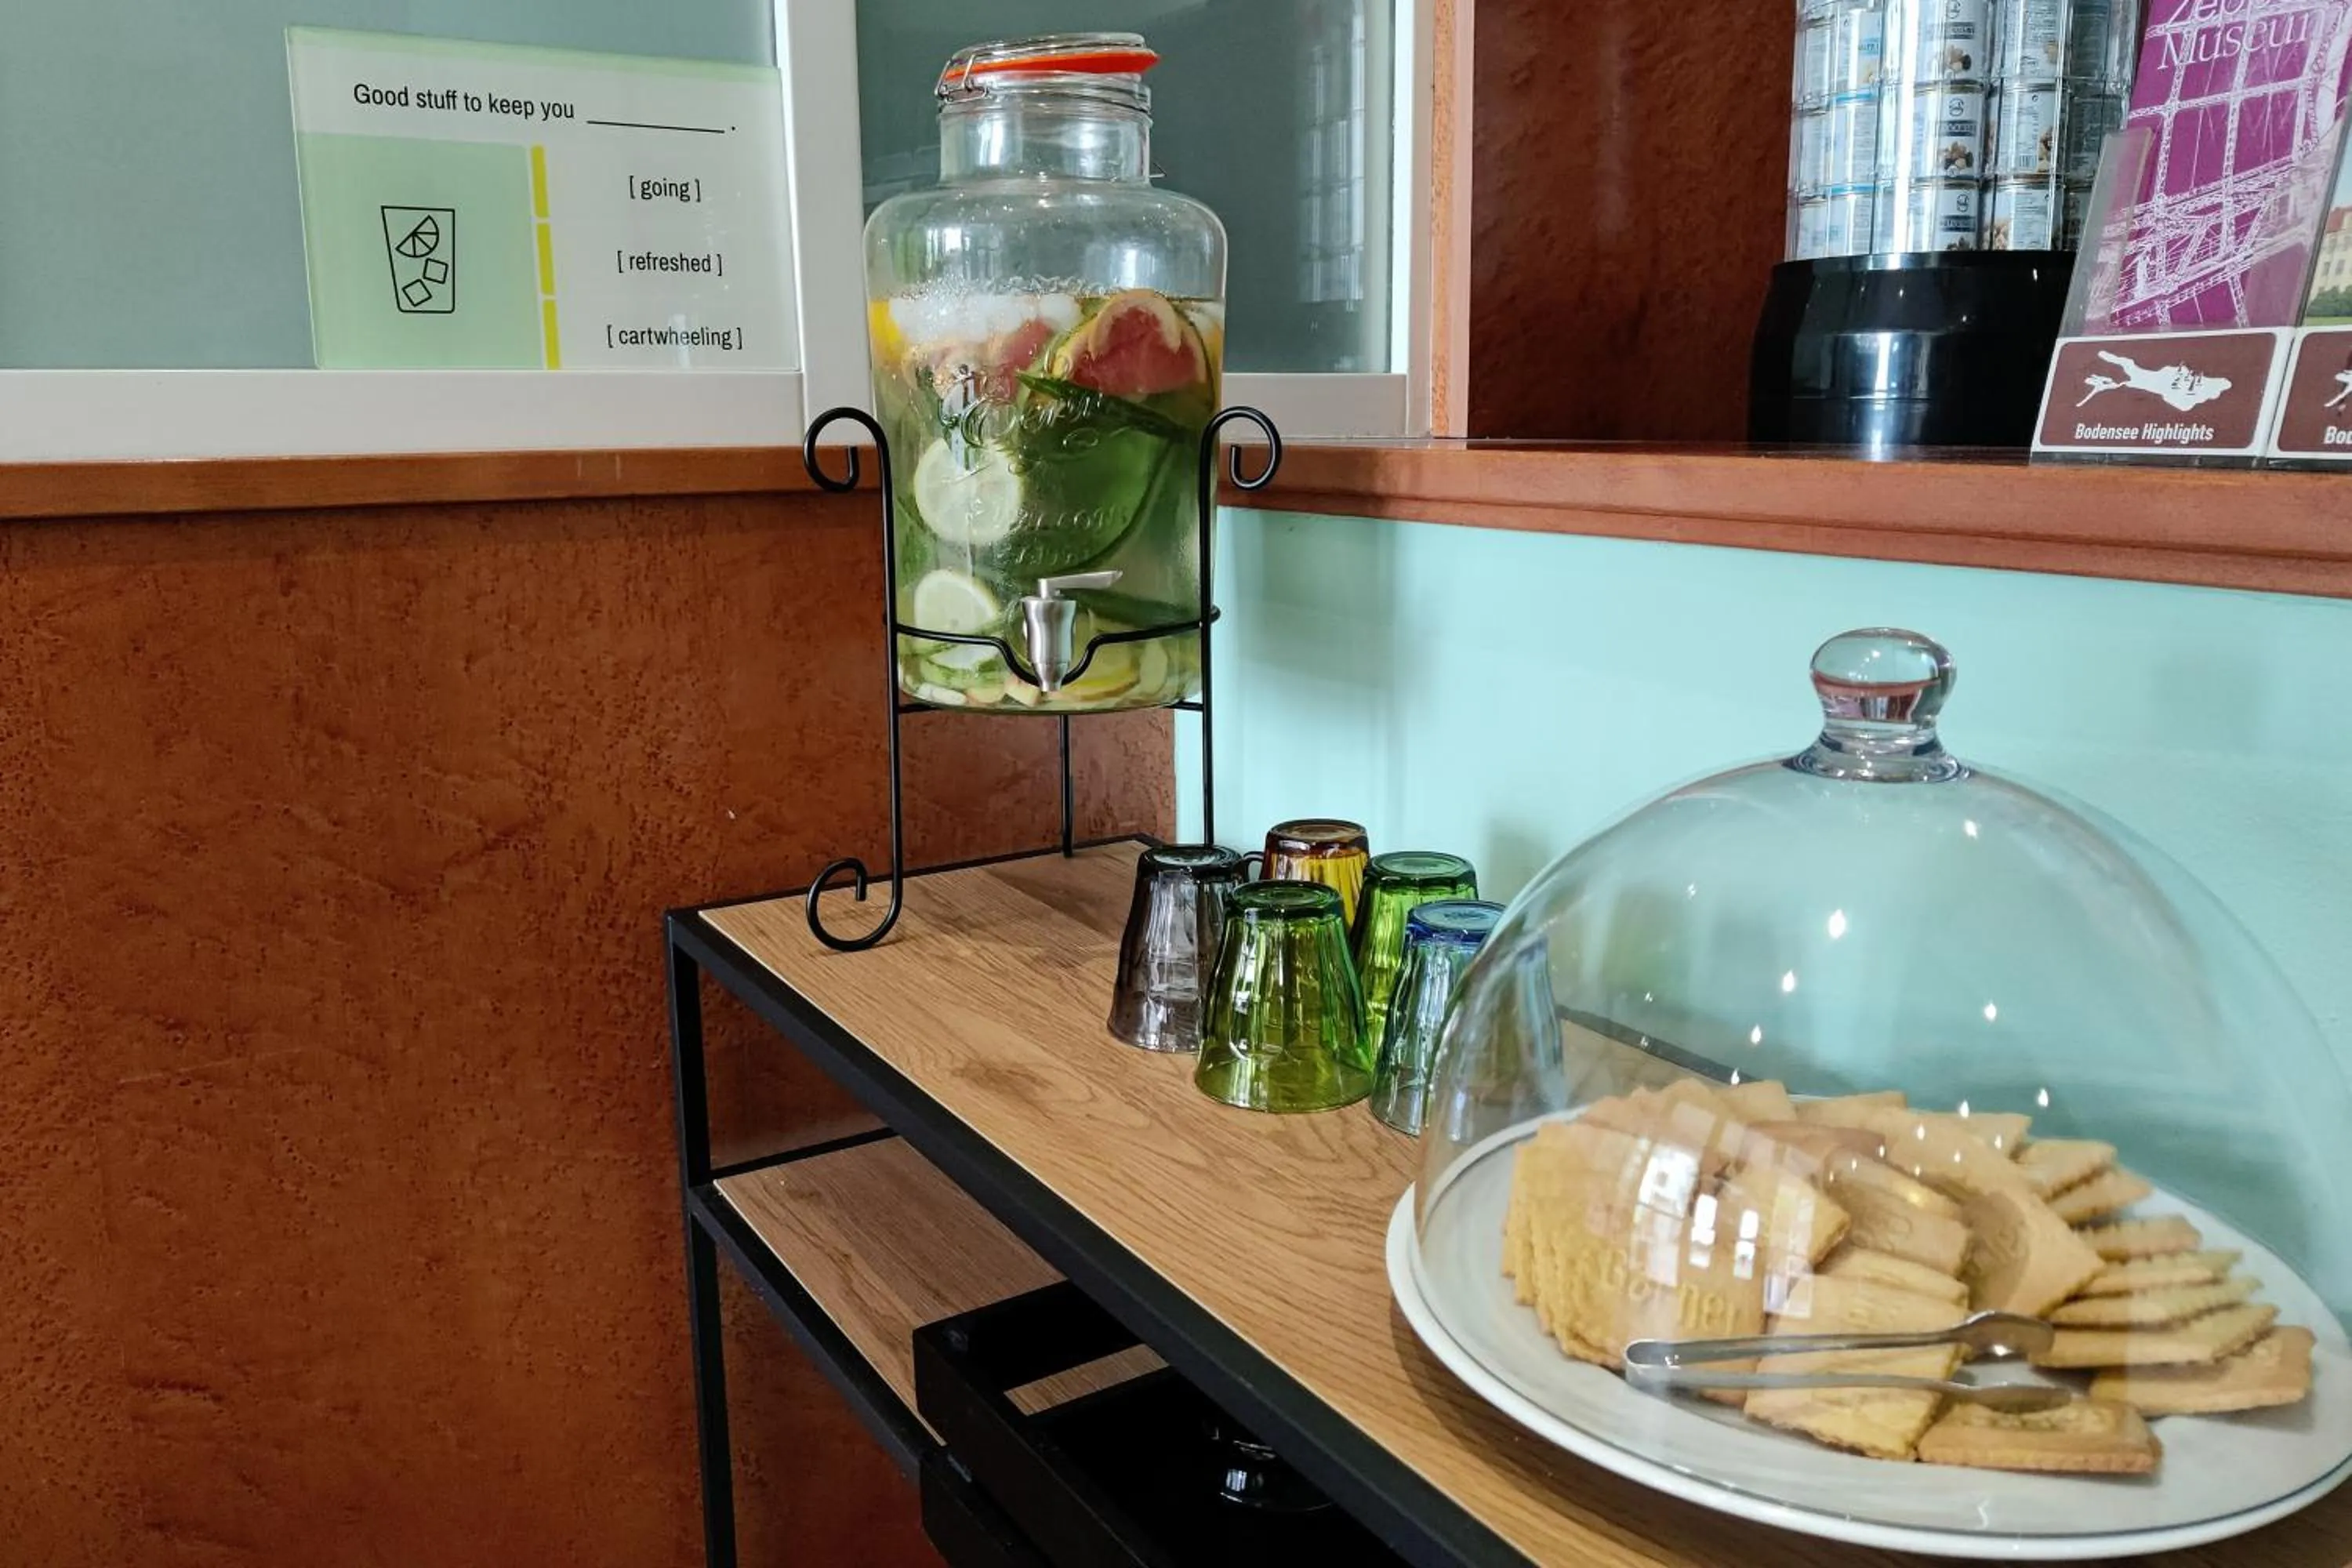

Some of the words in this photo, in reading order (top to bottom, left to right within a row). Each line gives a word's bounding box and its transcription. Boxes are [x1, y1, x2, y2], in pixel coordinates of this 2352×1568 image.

[354, 83, 409, 107] Good
[416, 89, 458, 111] stuff
[463, 92, 482, 112] to
[488, 92, 535, 121] keep
[540, 101, 575, 122] you
[2074, 423, 2139, 441] Bodensee
[2141, 423, 2215, 445] Highlights
